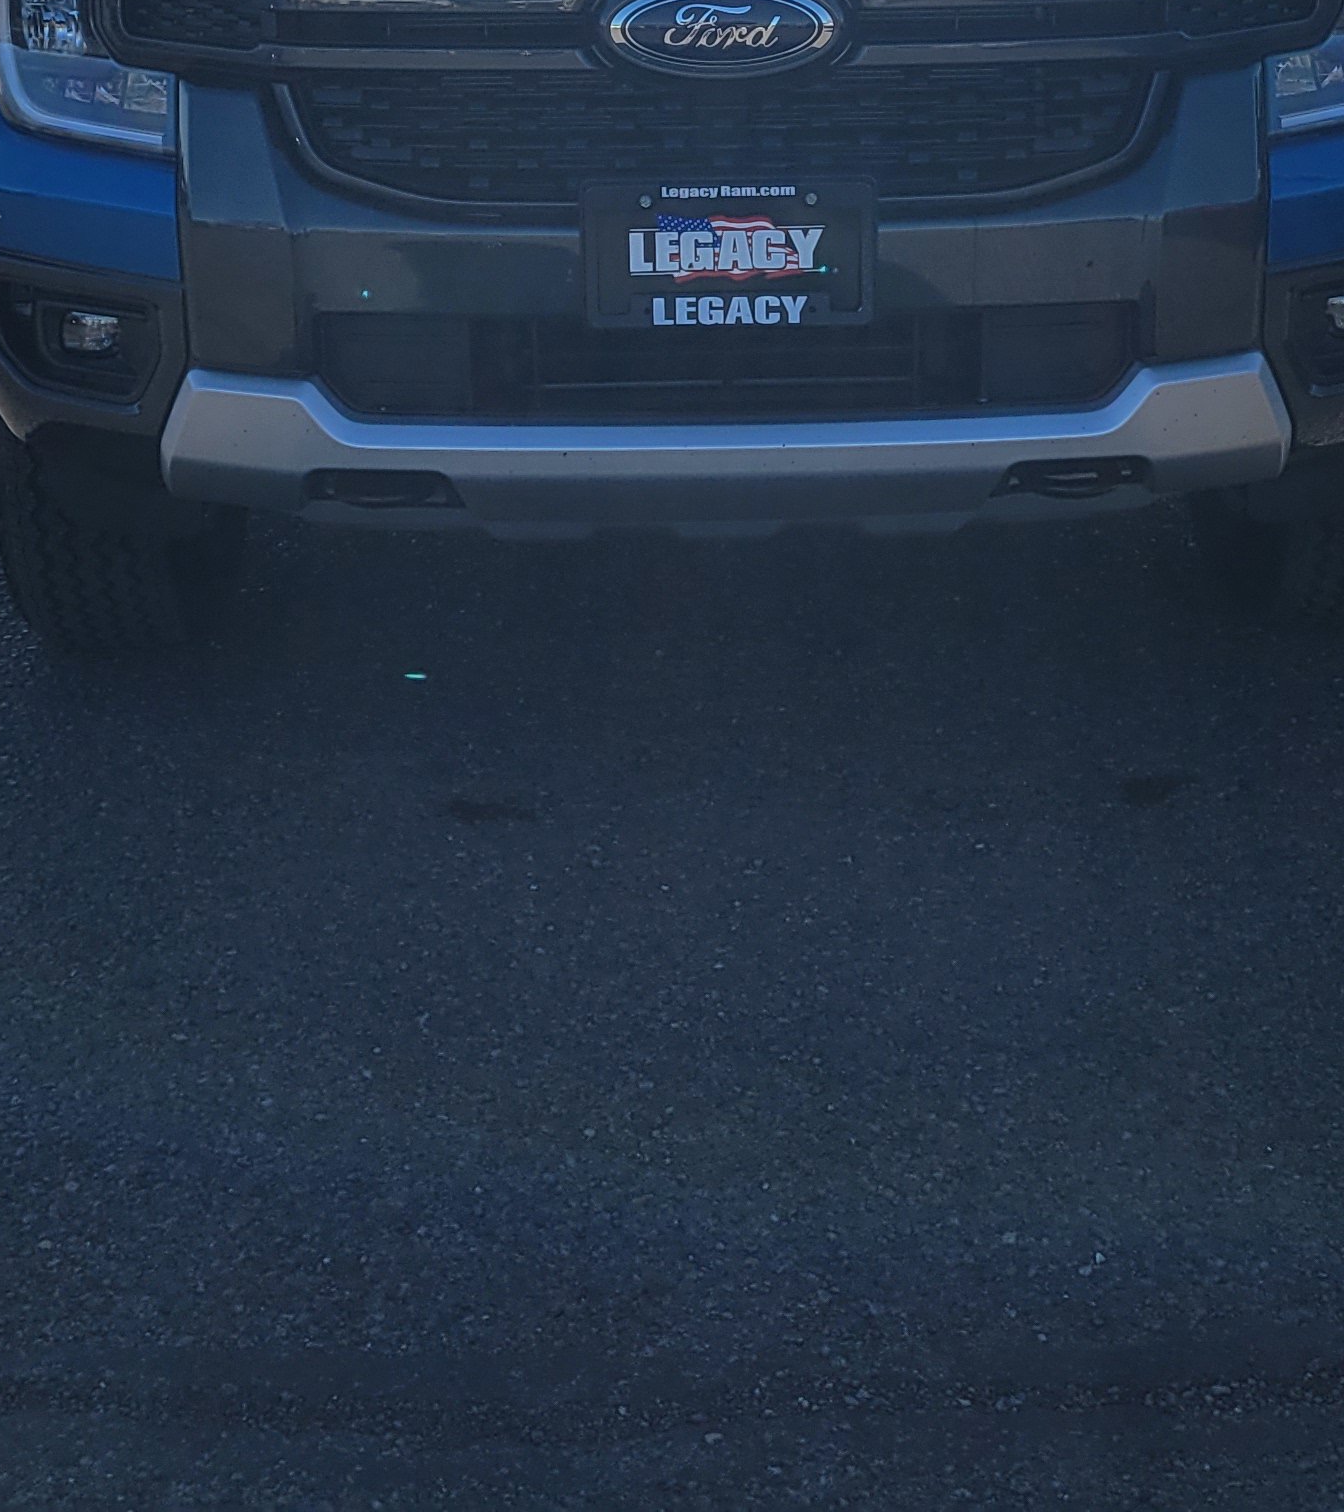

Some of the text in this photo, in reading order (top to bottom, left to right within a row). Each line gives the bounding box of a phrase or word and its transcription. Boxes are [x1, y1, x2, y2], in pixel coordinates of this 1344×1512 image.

[663, 3, 780, 49] Ford
[628, 229, 823, 272] LEGACY
[652, 296, 807, 325] LEGACY
